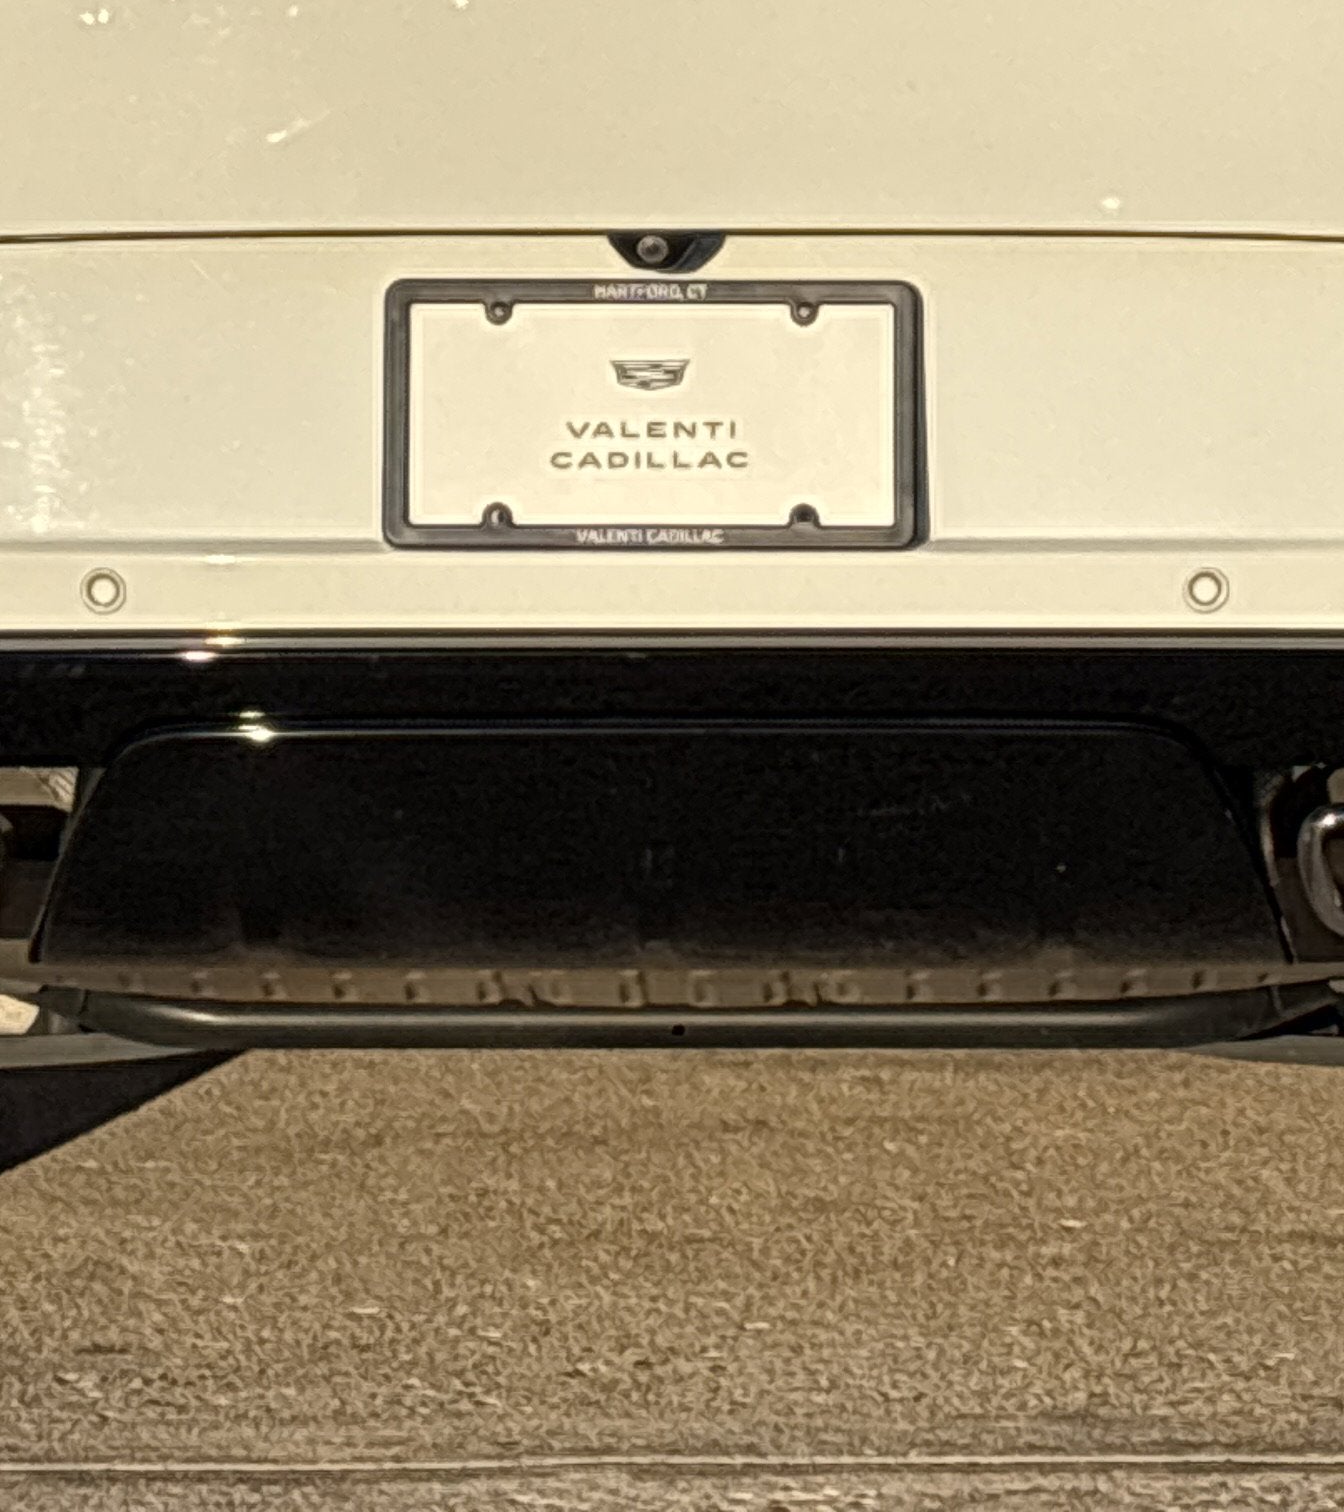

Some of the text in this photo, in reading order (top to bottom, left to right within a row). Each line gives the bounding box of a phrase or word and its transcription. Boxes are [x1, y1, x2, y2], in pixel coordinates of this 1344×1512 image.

[686, 283, 708, 301] CT
[565, 420, 737, 440] VALENTI
[550, 450, 749, 470] CADILLAC
[575, 528, 725, 545] VALENTI CADILLAC
